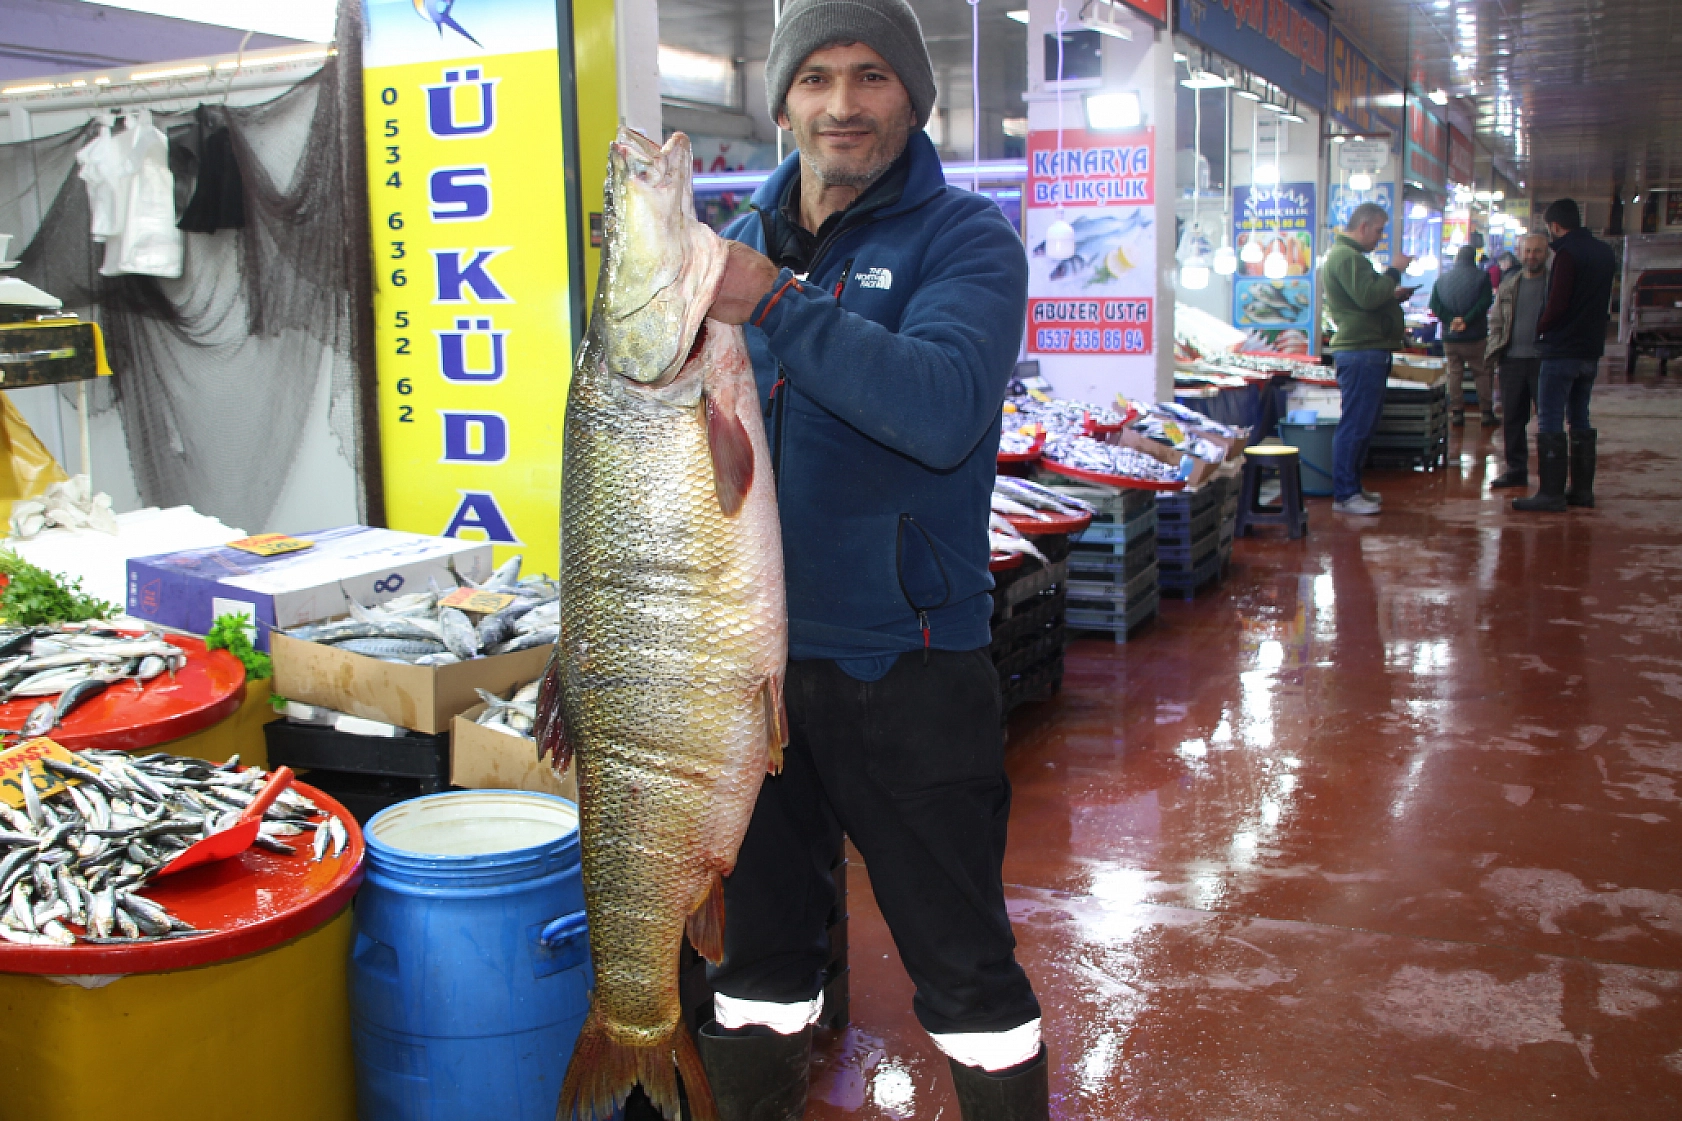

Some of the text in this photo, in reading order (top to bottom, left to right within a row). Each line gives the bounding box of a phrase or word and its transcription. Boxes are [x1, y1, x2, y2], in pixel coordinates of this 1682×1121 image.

[385, 120, 402, 188] 534
[1035, 149, 1148, 176] KANARYA
[1036, 180, 1146, 206] BALIKÇILIK
[388, 213, 407, 287] 636
[1034, 302, 1147, 323] ABUZER USTA
[394, 312, 411, 354] 52
[1037, 328, 1143, 350] 0537 336 86 94
[397, 378, 415, 422] 62
